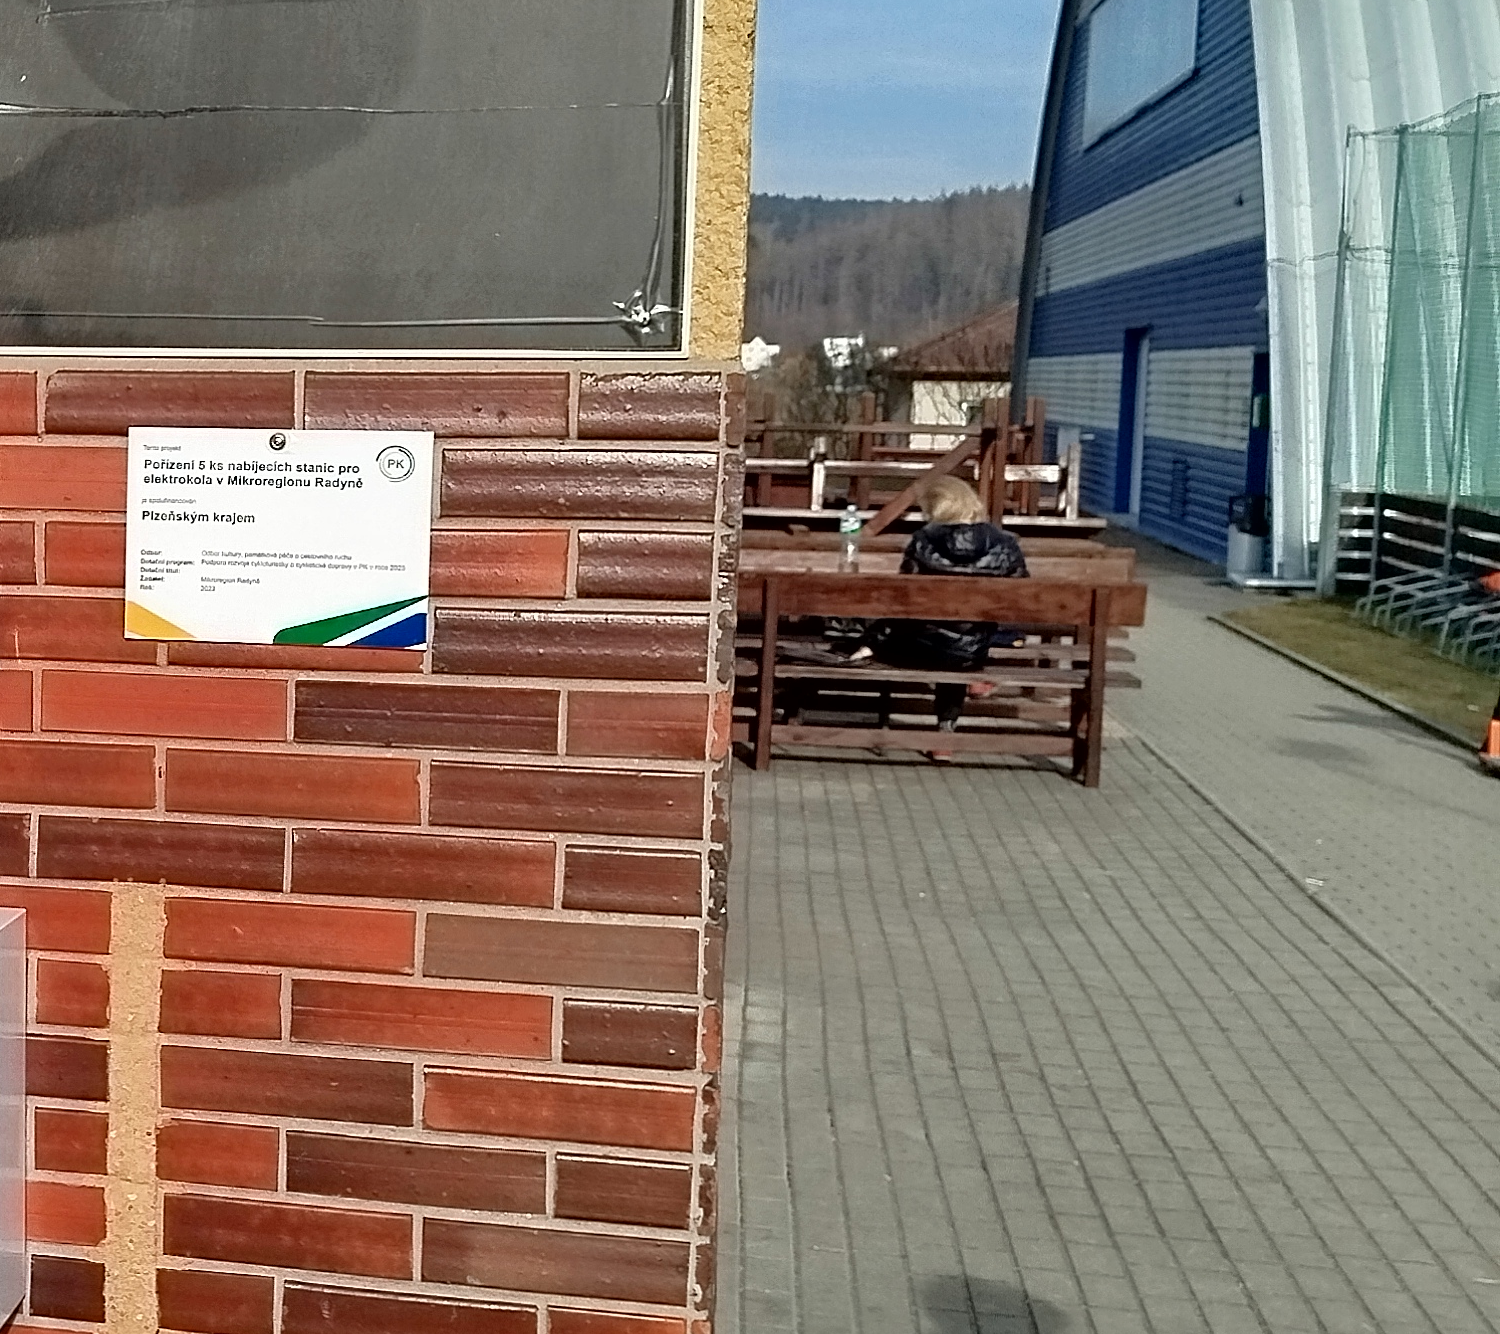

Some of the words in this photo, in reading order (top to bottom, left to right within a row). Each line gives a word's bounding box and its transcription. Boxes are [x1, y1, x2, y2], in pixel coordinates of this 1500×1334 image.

[143, 458, 195, 471] Pořízení
[198, 460, 206, 470] 5
[209, 460, 224, 471] ks
[227, 460, 292, 474] nabíjecích
[295, 462, 335, 473] stanic
[338, 464, 360, 475] pro
[387, 459, 405, 469] PK
[143, 473, 213, 485] elektrokola
[216, 477, 224, 485] v
[227, 475, 311, 489] Mikroregionu
[314, 477, 363, 491] Radyně
[141, 510, 209, 524] Plzeňským
[213, 512, 256, 525] krajem
